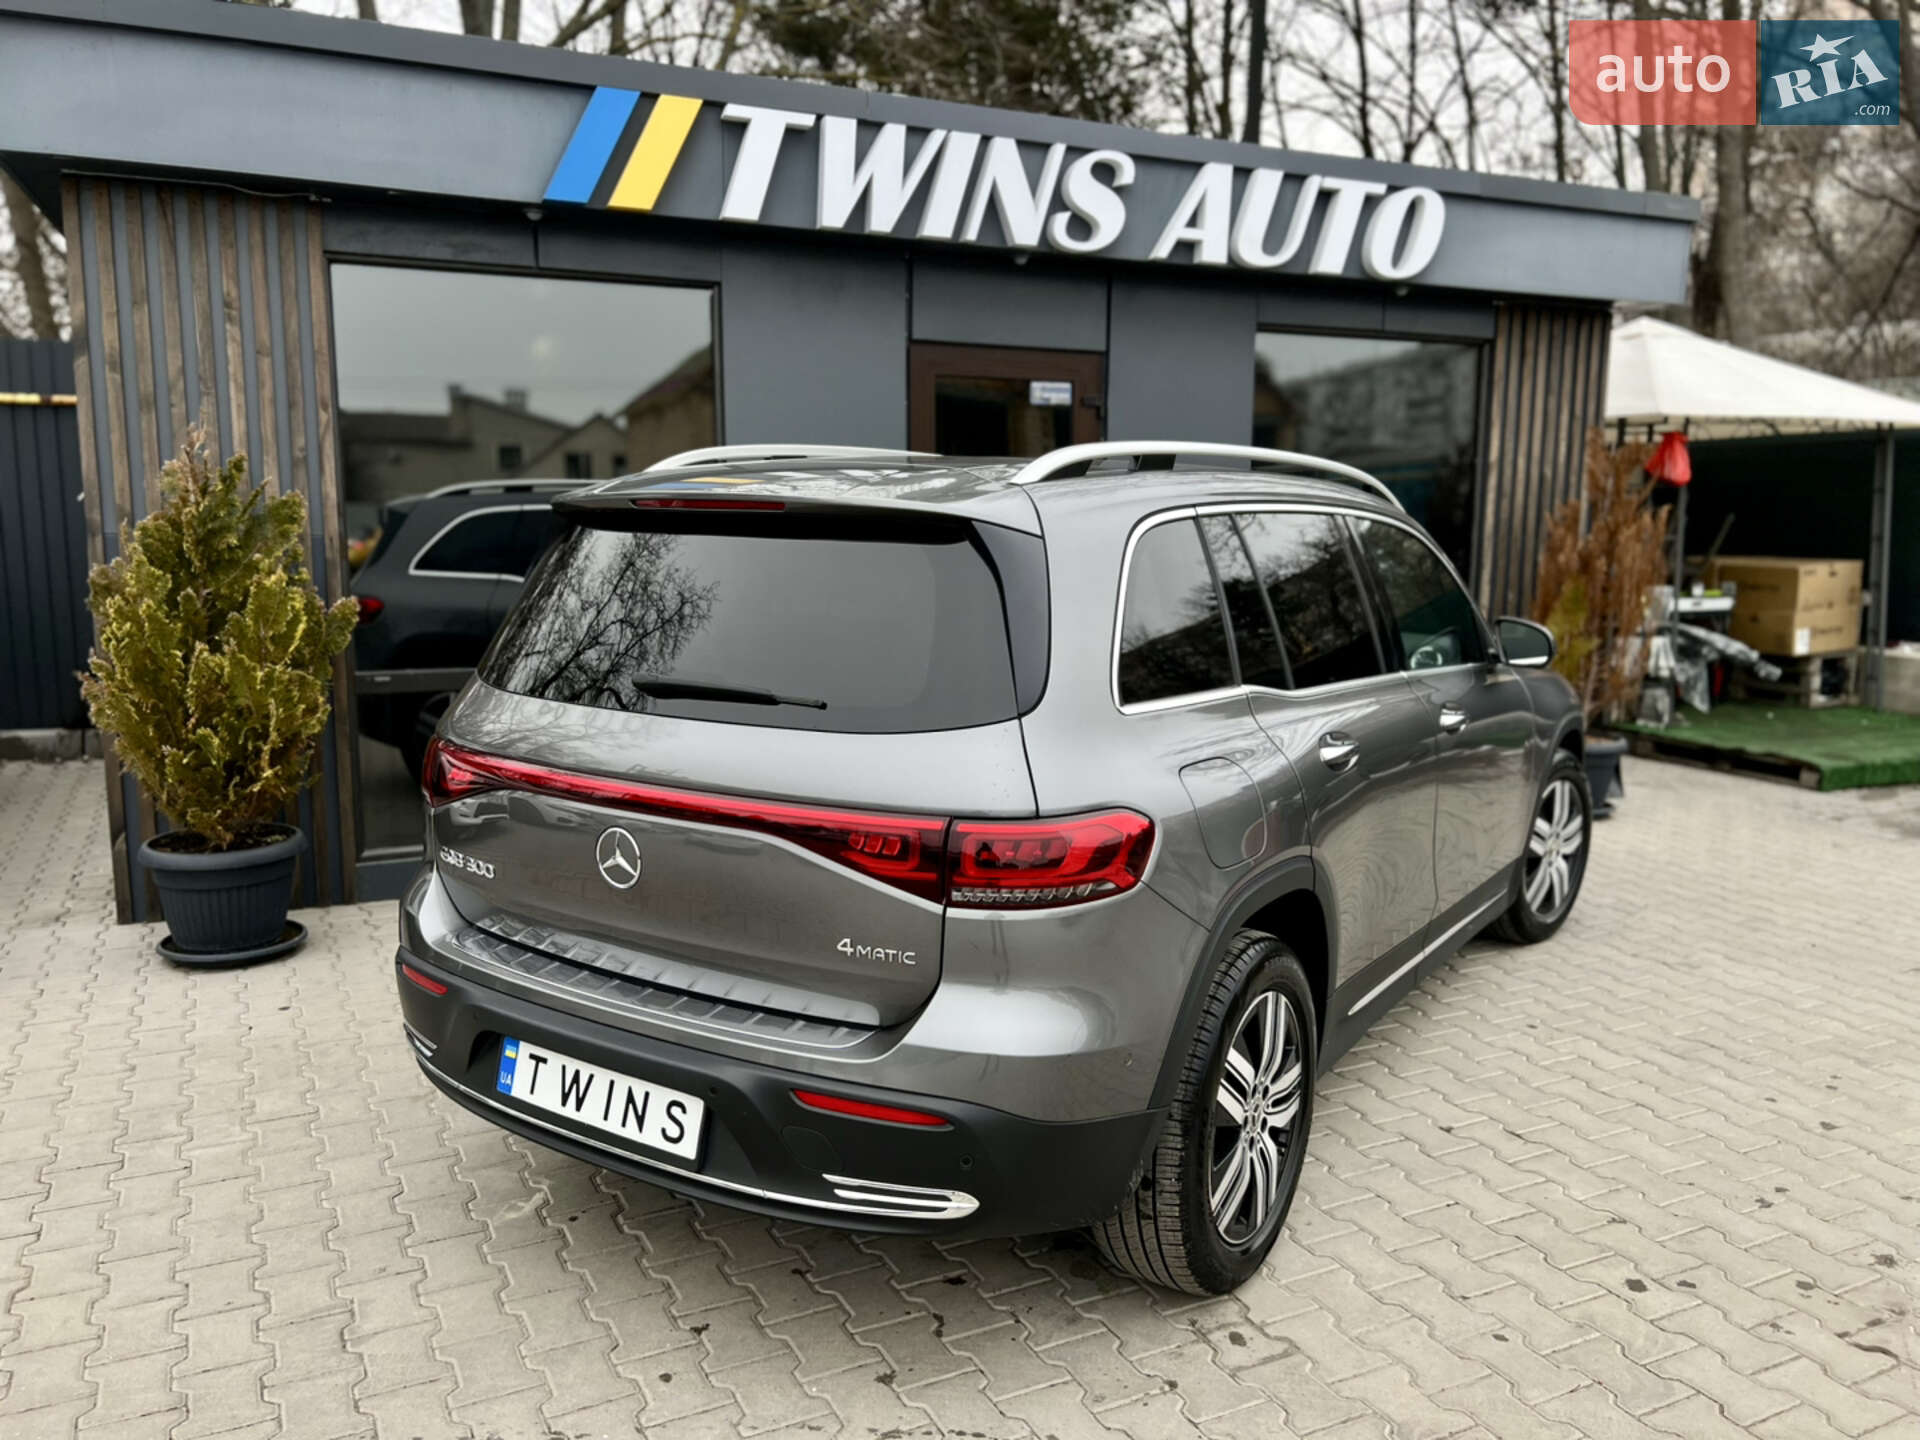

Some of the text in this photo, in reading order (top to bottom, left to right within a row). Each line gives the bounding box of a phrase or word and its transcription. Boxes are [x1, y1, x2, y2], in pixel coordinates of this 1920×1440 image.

[719, 103, 1446, 280] TWINS AUTO
[836, 938, 916, 965] 4MATIC
[500, 1071, 512, 1086] UA
[528, 1053, 687, 1144] TWINS
